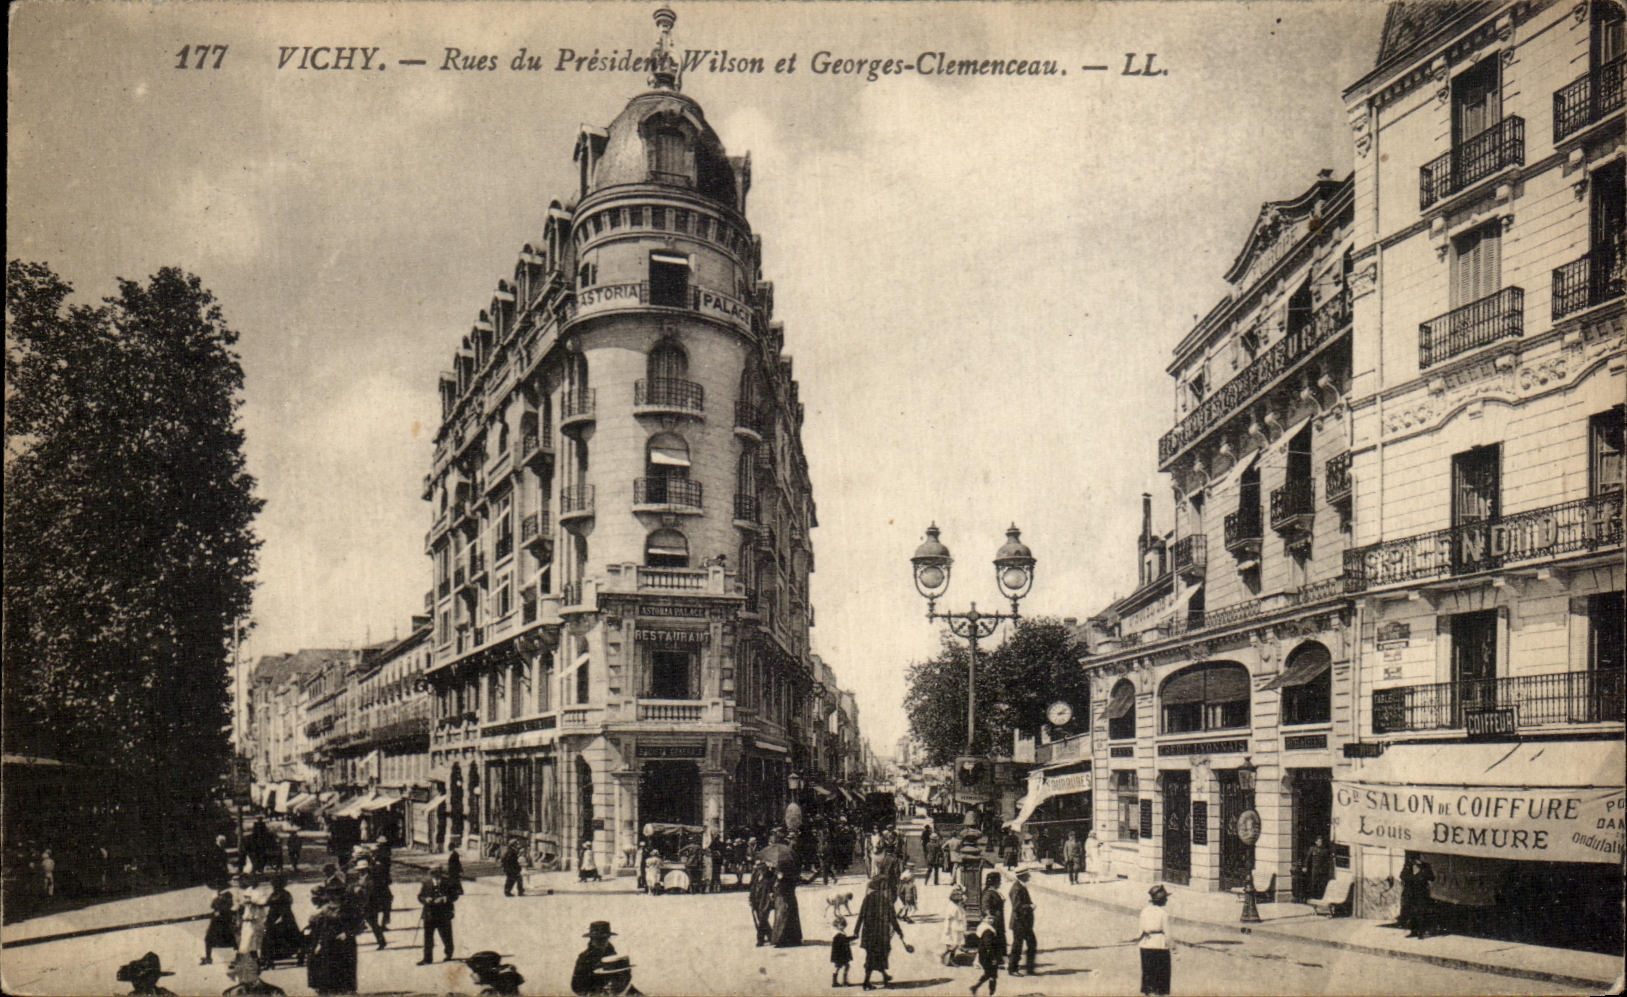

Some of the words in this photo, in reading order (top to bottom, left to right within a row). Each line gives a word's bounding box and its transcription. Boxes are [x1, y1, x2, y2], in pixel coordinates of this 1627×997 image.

[580, 285, 639, 307] ASTORIA
[634, 629, 711, 643] RESTAURANT
[1467, 711, 1514, 735] COIFFEUR
[1366, 791, 1435, 816] SALON
[1438, 802, 1451, 817] DE
[1456, 795, 1583, 820] COIFFURE
[1358, 815, 1413, 841] Louis
[1432, 822, 1550, 850] DEMURE
